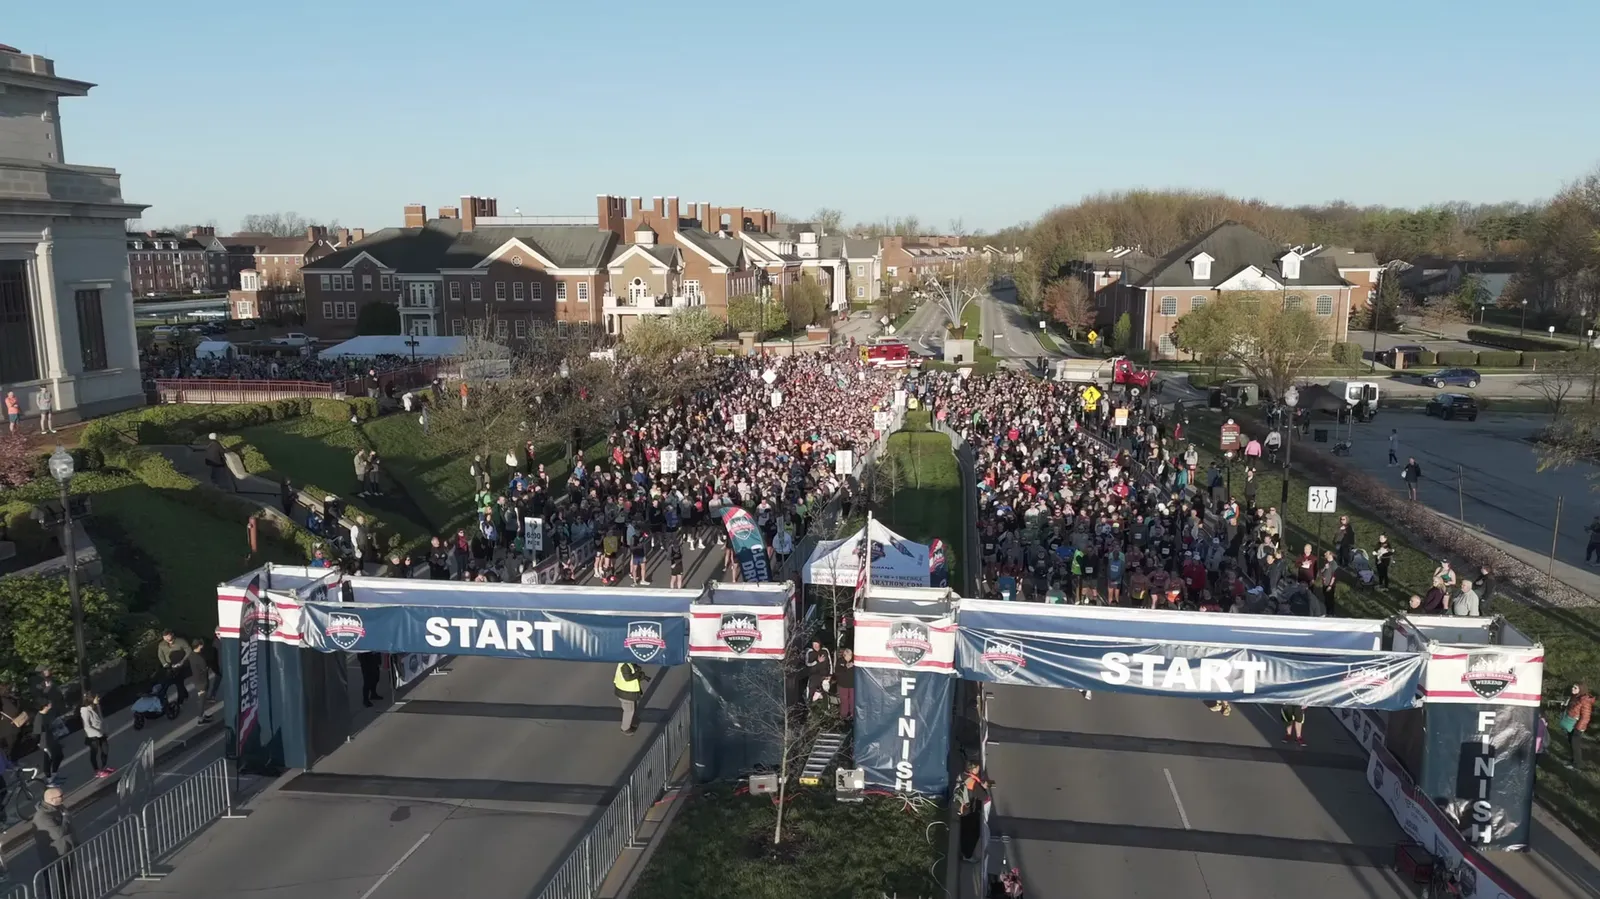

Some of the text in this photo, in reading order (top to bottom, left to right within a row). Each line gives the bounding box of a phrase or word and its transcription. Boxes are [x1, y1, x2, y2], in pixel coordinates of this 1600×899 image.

[425, 616, 561, 651] START
[241, 641, 250, 713] RELAY
[1100, 652, 1266, 694] START
[895, 677, 916, 792] FINISH
[1471, 711, 1496, 843] FINISH
